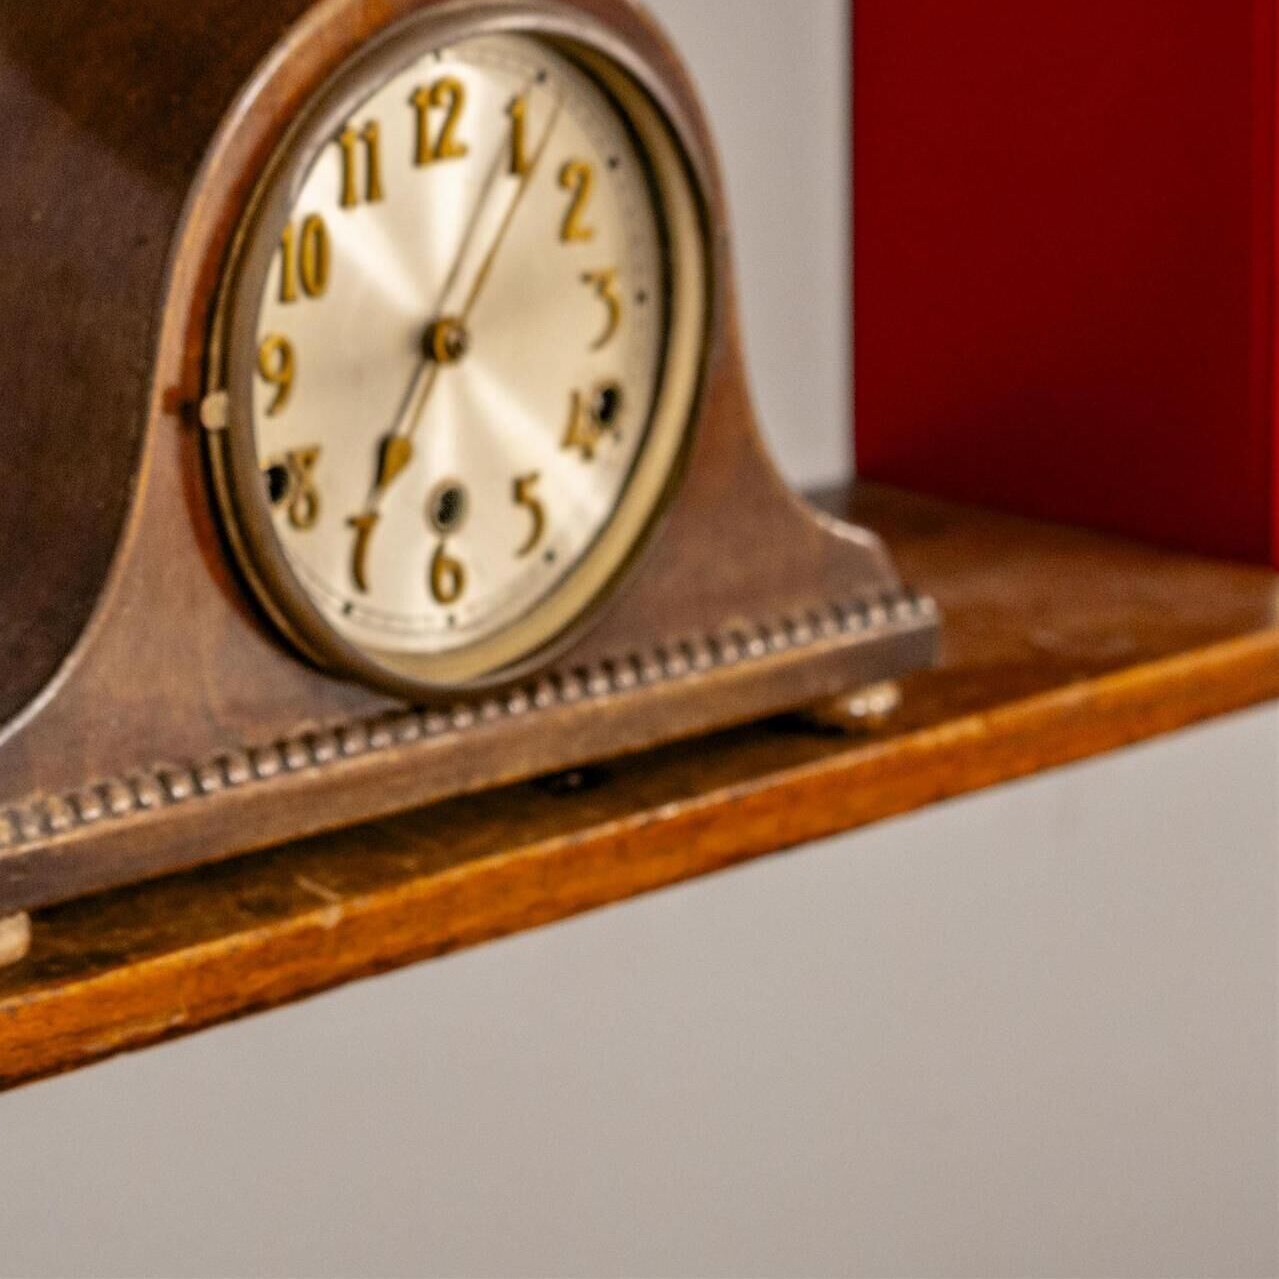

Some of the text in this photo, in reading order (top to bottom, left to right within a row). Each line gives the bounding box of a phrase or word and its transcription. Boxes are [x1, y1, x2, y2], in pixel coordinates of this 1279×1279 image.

[336, 118, 384, 210] 11
[410, 75, 470, 169] 12
[502, 94, 532, 177] 1
[556, 159, 595, 244] 2
[278, 212, 333, 304] 10
[582, 267, 621, 352] 3
[257, 333, 296, 417] 9
[561, 389, 597, 462] 4
[287, 446, 320, 531] 8
[511, 471, 548, 560] 5
[345, 511, 380, 595] 7
[428, 535, 466, 605] 6
